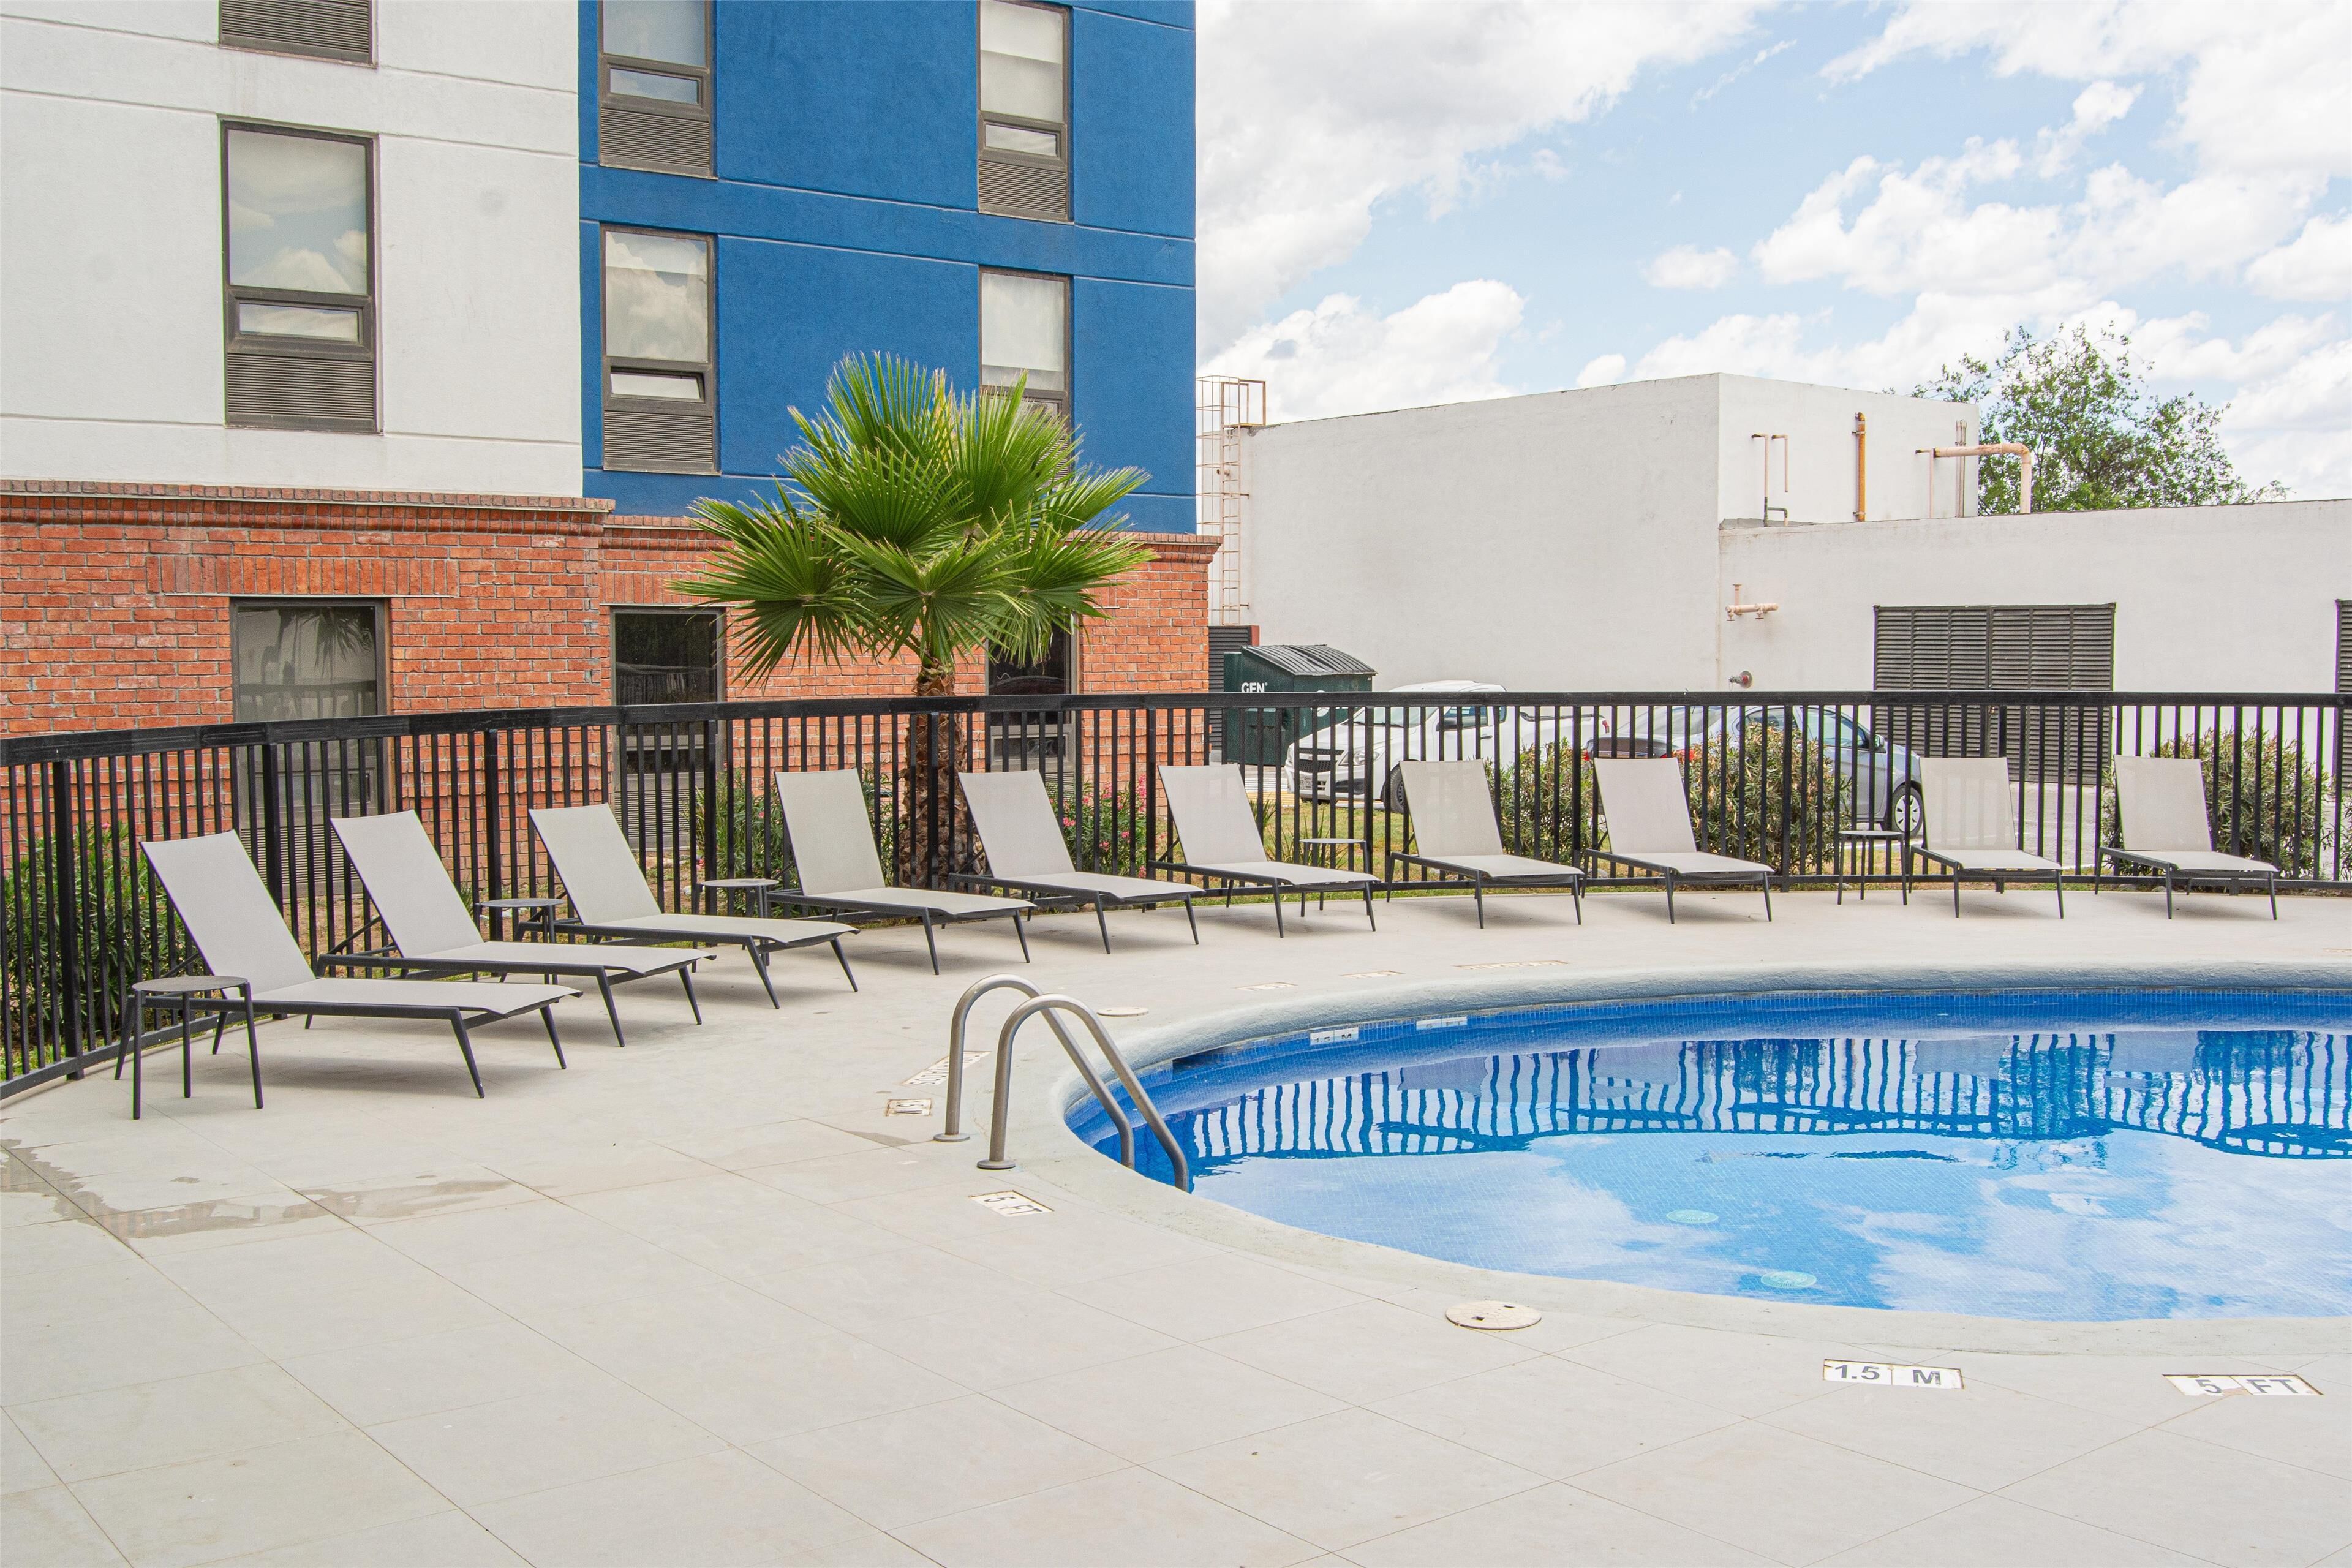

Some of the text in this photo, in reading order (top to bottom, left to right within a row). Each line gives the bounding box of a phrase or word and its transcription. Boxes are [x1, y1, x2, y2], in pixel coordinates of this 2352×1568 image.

[998, 1204, 1042, 1215] FT
[1835, 1365, 1941, 1385] 1.5 M
[2195, 1379, 2299, 1393] 5 FT
